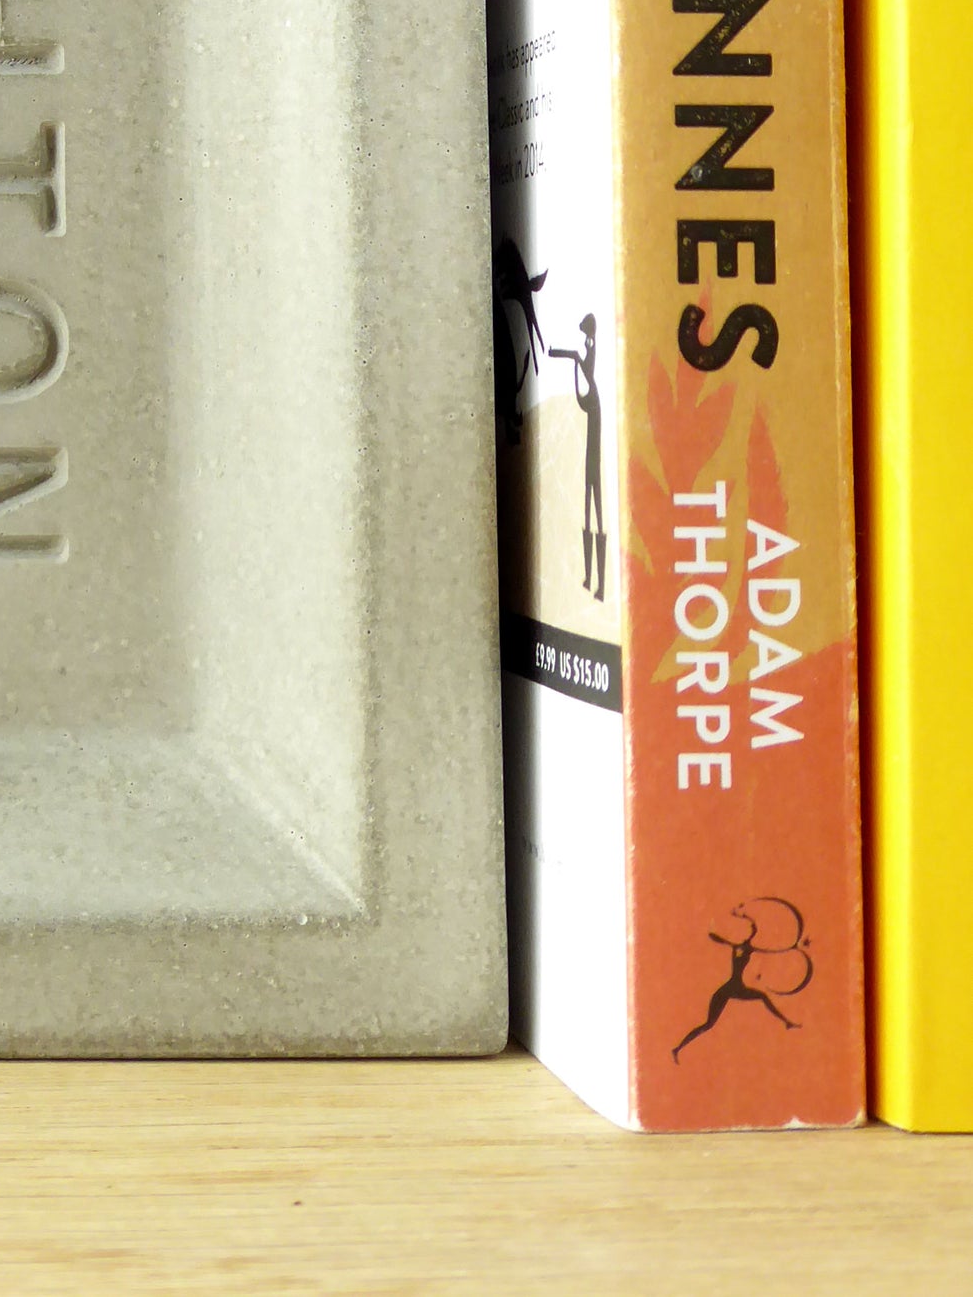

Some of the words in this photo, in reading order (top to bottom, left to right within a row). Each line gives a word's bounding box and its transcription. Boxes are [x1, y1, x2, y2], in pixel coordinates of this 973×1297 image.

[535, 641, 556, 674] £9.99
[559, 650, 571, 680] US
[573, 654, 609, 693] $15.00
[673, 480, 733, 791] THORPE
[746, 518, 806, 749] ADAM
